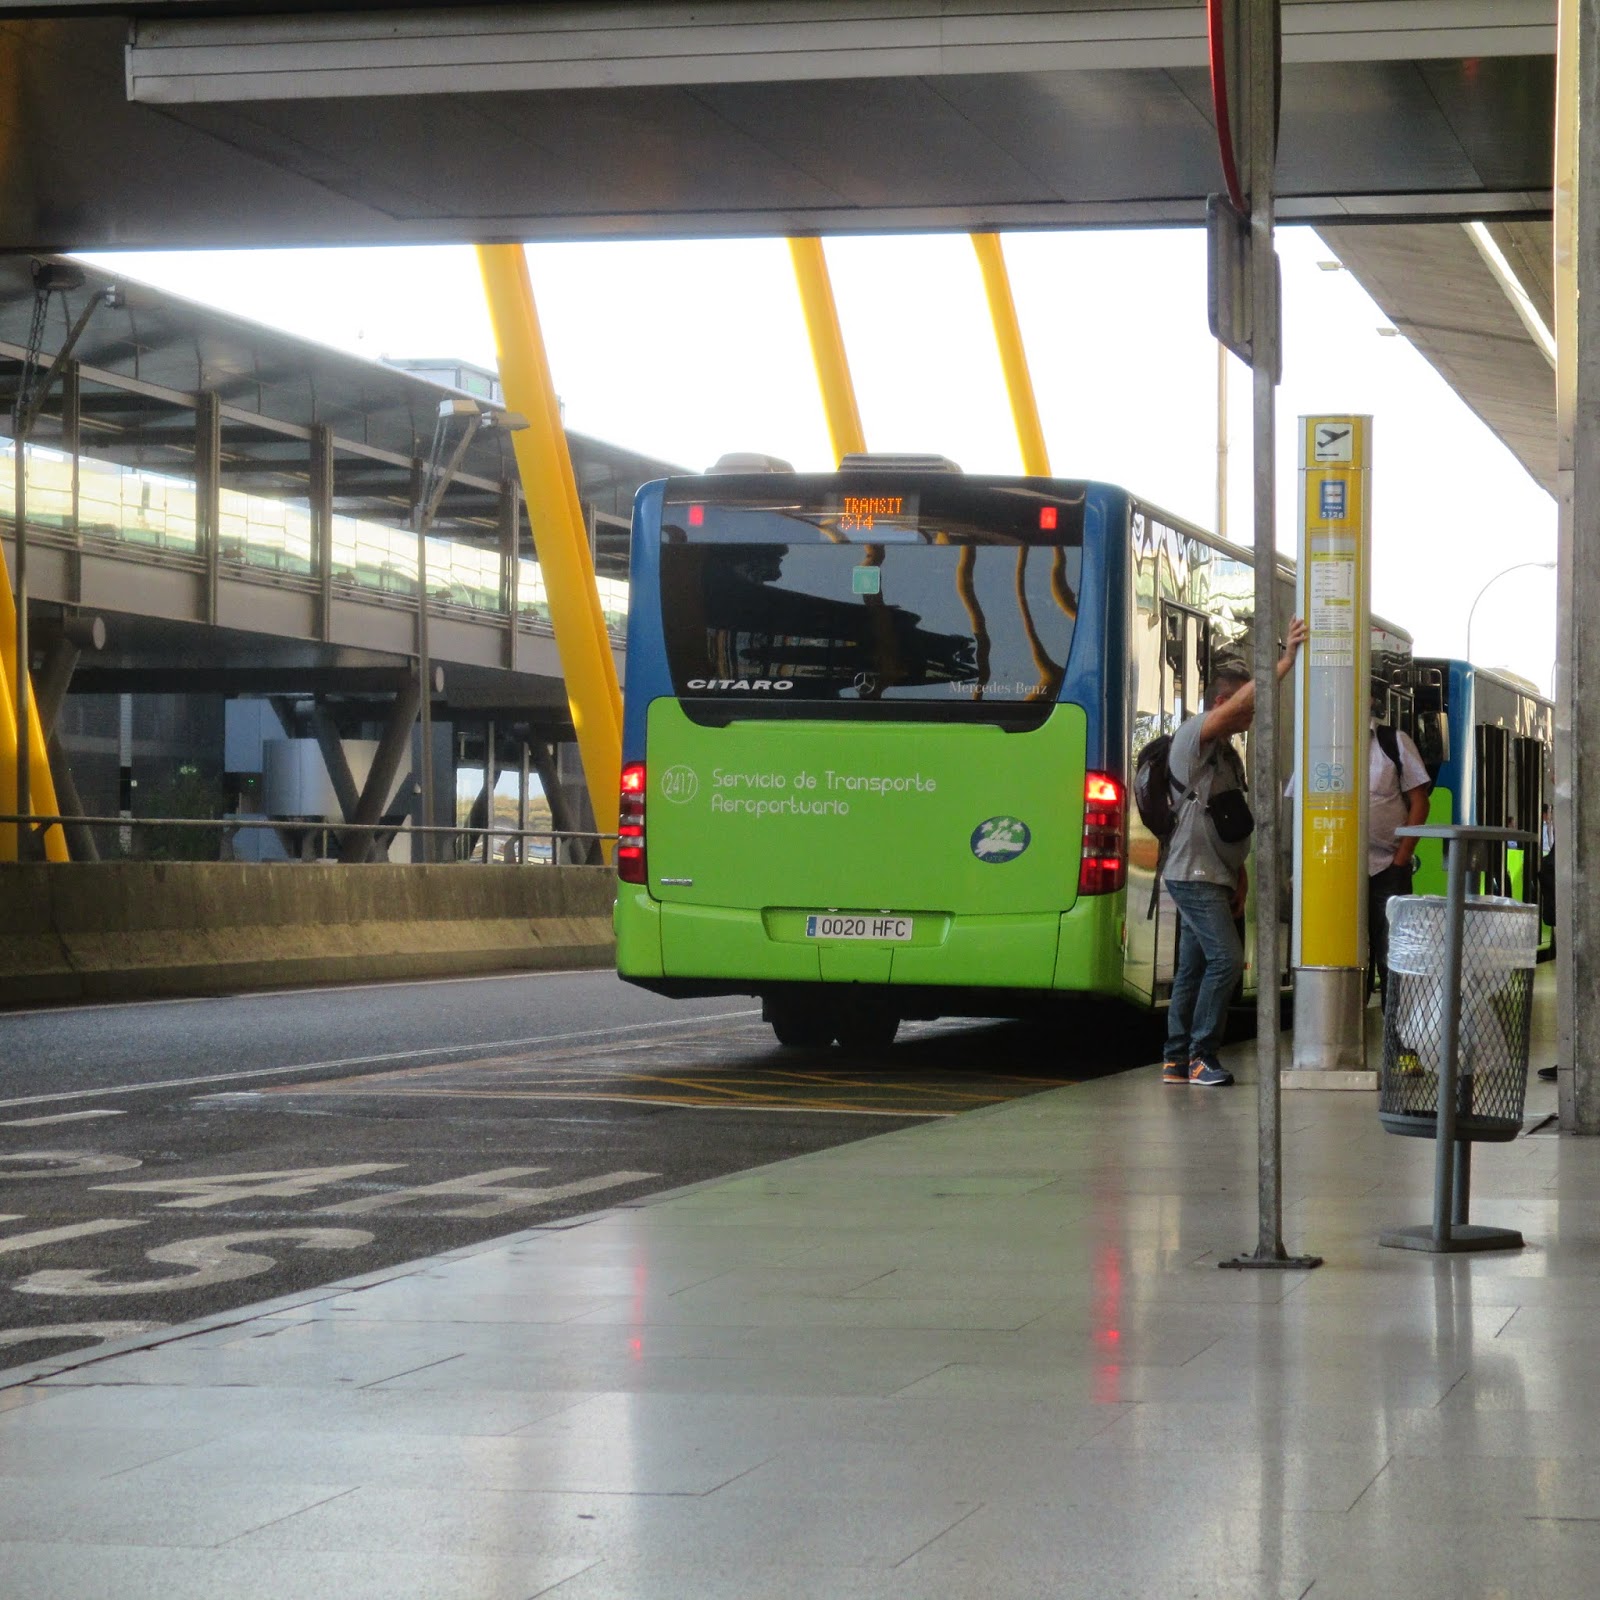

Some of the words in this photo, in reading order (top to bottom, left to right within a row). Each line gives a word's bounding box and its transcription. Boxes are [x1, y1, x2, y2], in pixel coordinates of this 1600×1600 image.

[843, 497, 903, 514] TRANSIT
[686, 679, 794, 691] CITARO
[664, 772, 696, 795] 2417
[712, 769, 786, 789] Servicio
[793, 770, 817, 790] de
[825, 770, 937, 797] Transporte
[711, 793, 850, 818] Aeroportuario
[1313, 817, 1346, 830] EMT
[821, 918, 866, 936] 0020
[872, 919, 906, 937] HFC
